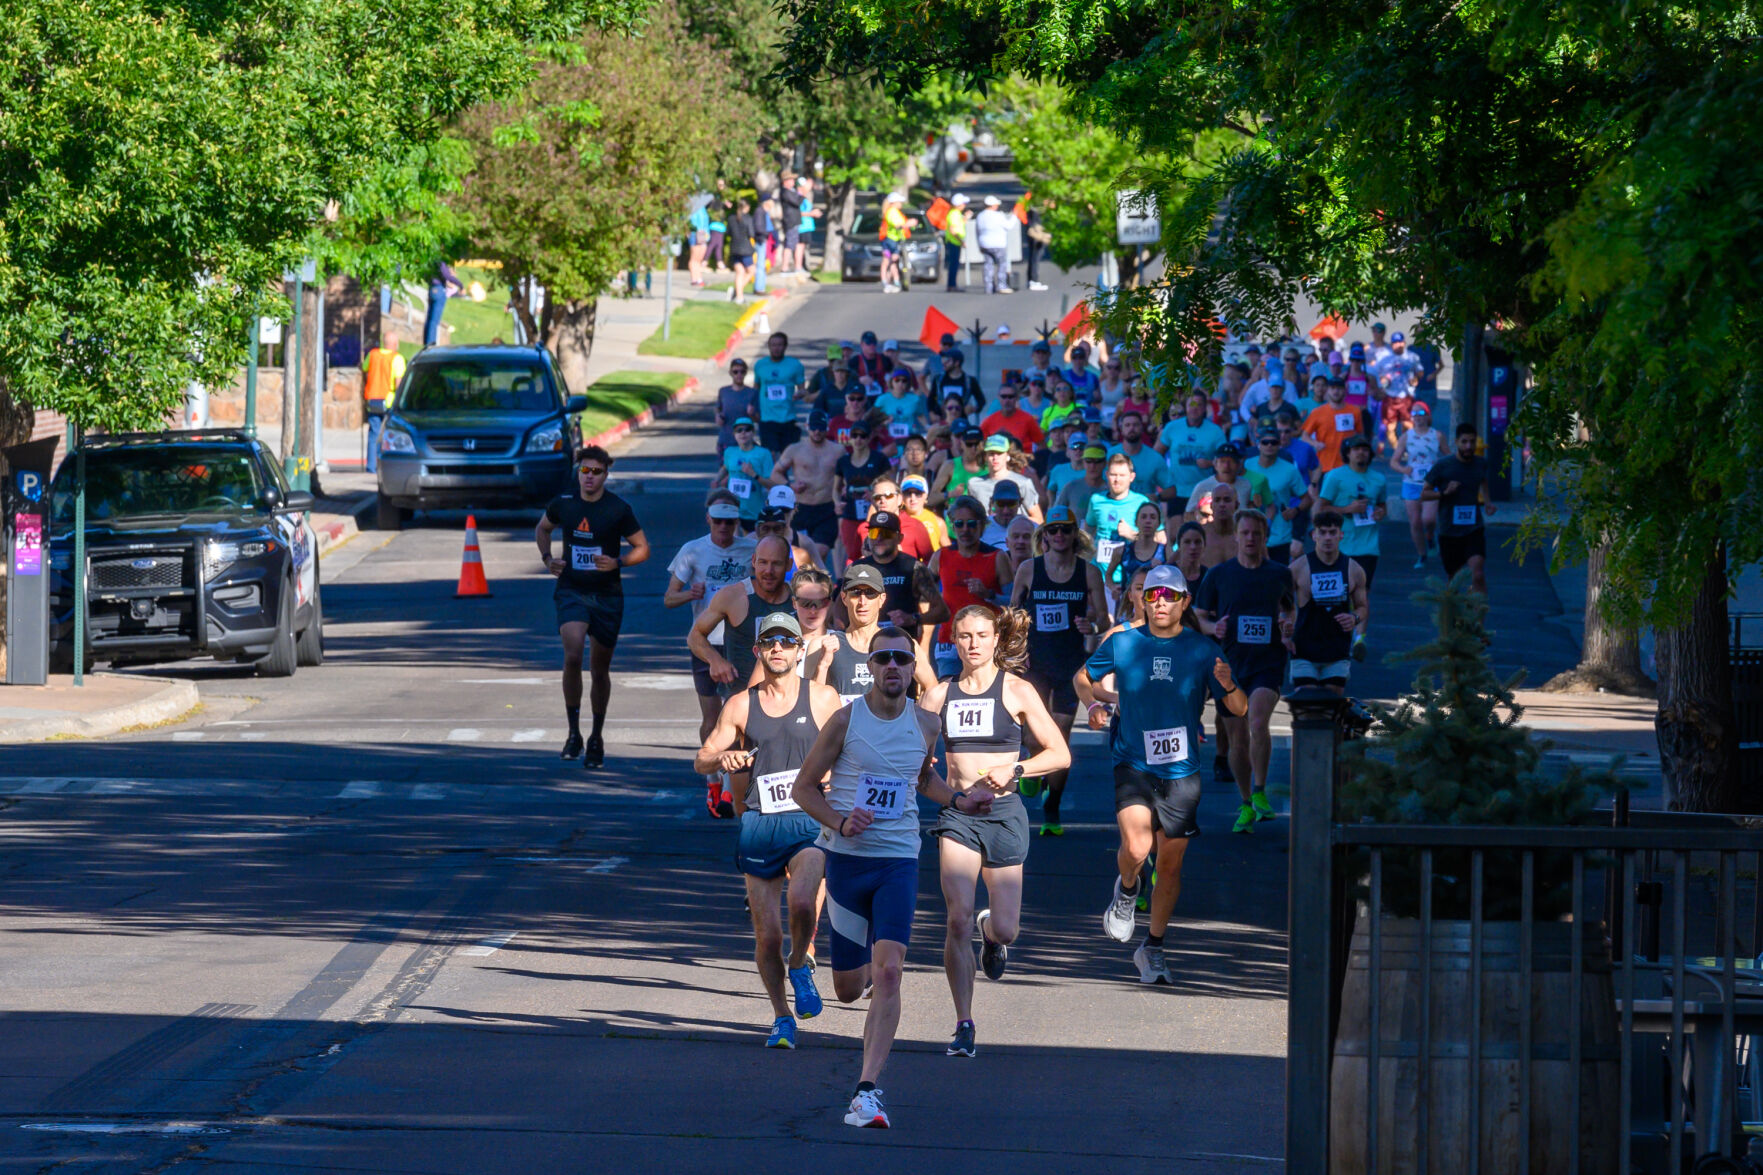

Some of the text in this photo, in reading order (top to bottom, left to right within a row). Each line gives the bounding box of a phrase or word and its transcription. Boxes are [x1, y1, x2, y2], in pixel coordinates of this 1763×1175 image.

[1493, 367, 1504, 384] P
[24, 474, 38, 496] P
[1317, 579, 1337, 591] 222
[1033, 590, 1084, 601] RUN FLAGSTAFF
[1042, 611, 1062, 625] 130
[1244, 623, 1266, 636] 255
[958, 710, 981, 727] 141
[1152, 738, 1180, 756] 203
[865, 788, 897, 808] 241
